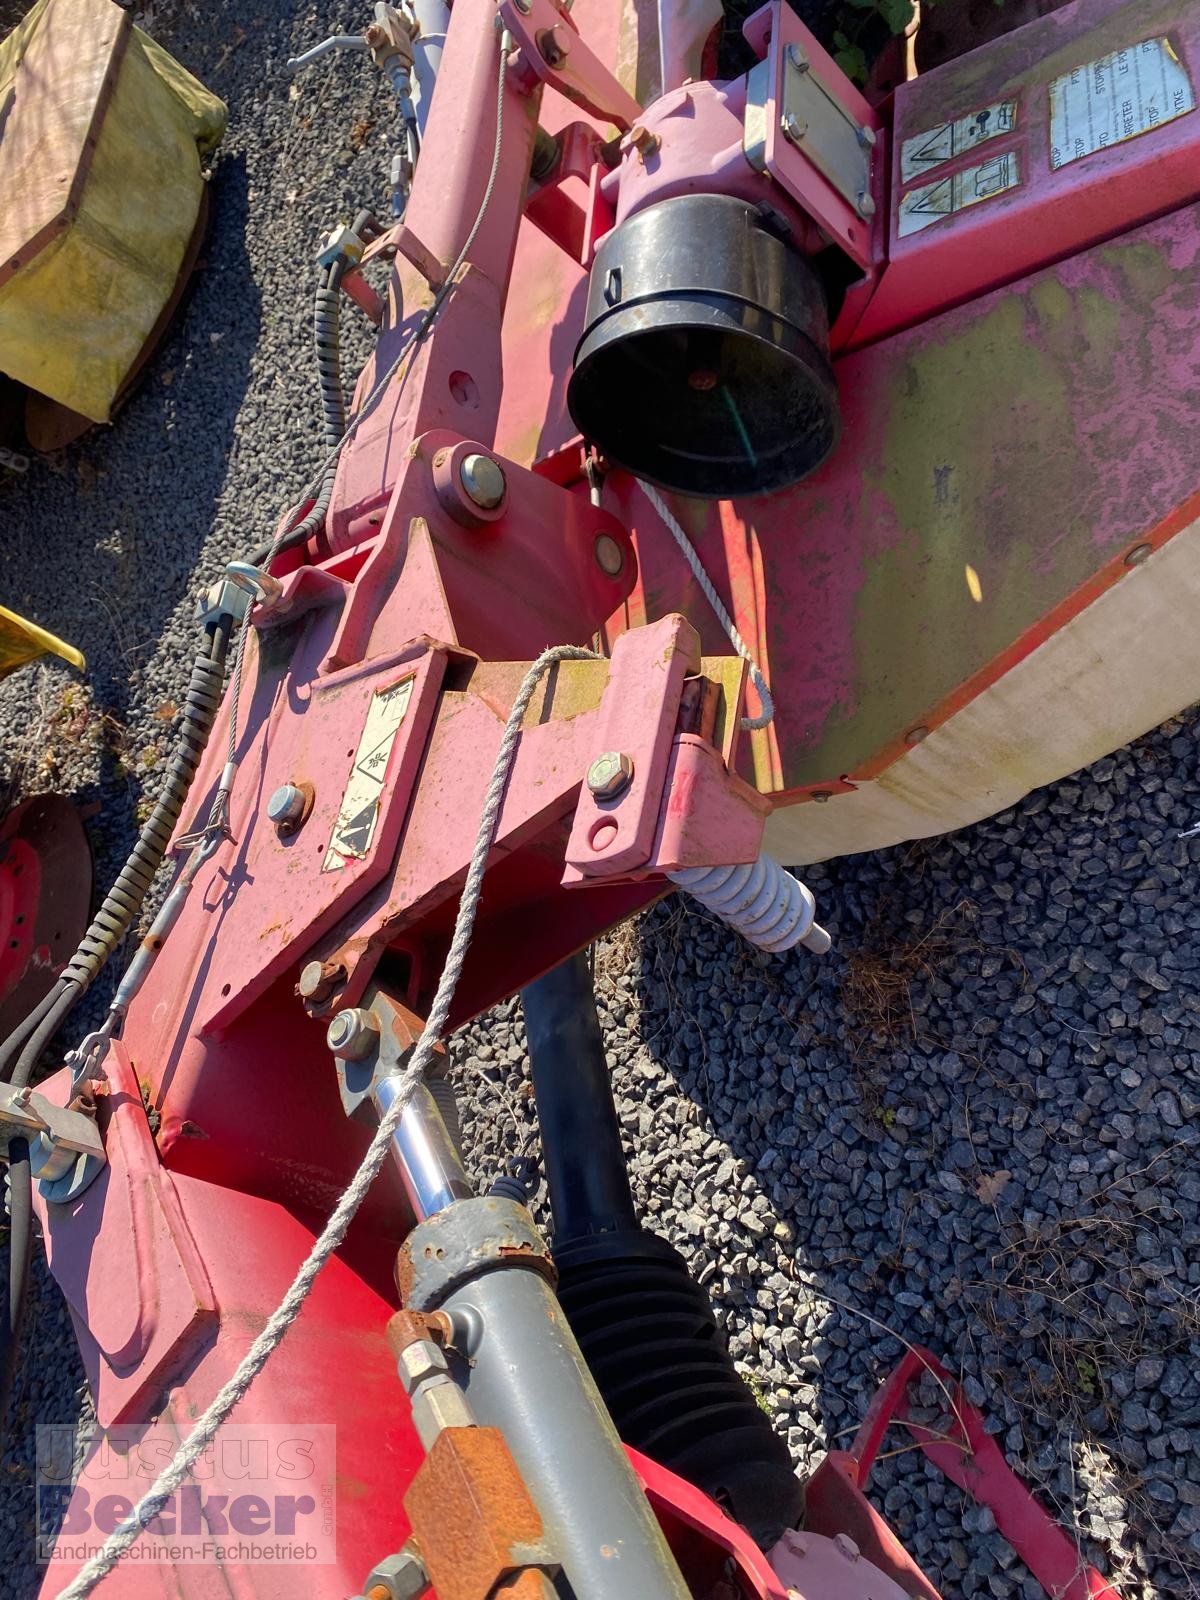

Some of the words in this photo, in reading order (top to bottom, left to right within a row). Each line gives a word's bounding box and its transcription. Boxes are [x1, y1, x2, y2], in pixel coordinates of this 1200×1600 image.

[1071, 68, 1080, 85] PTO
[1119, 63, 1128, 75] LE
[1075, 138, 1085, 158] STOP
[1052, 147, 1061, 168] STOP
